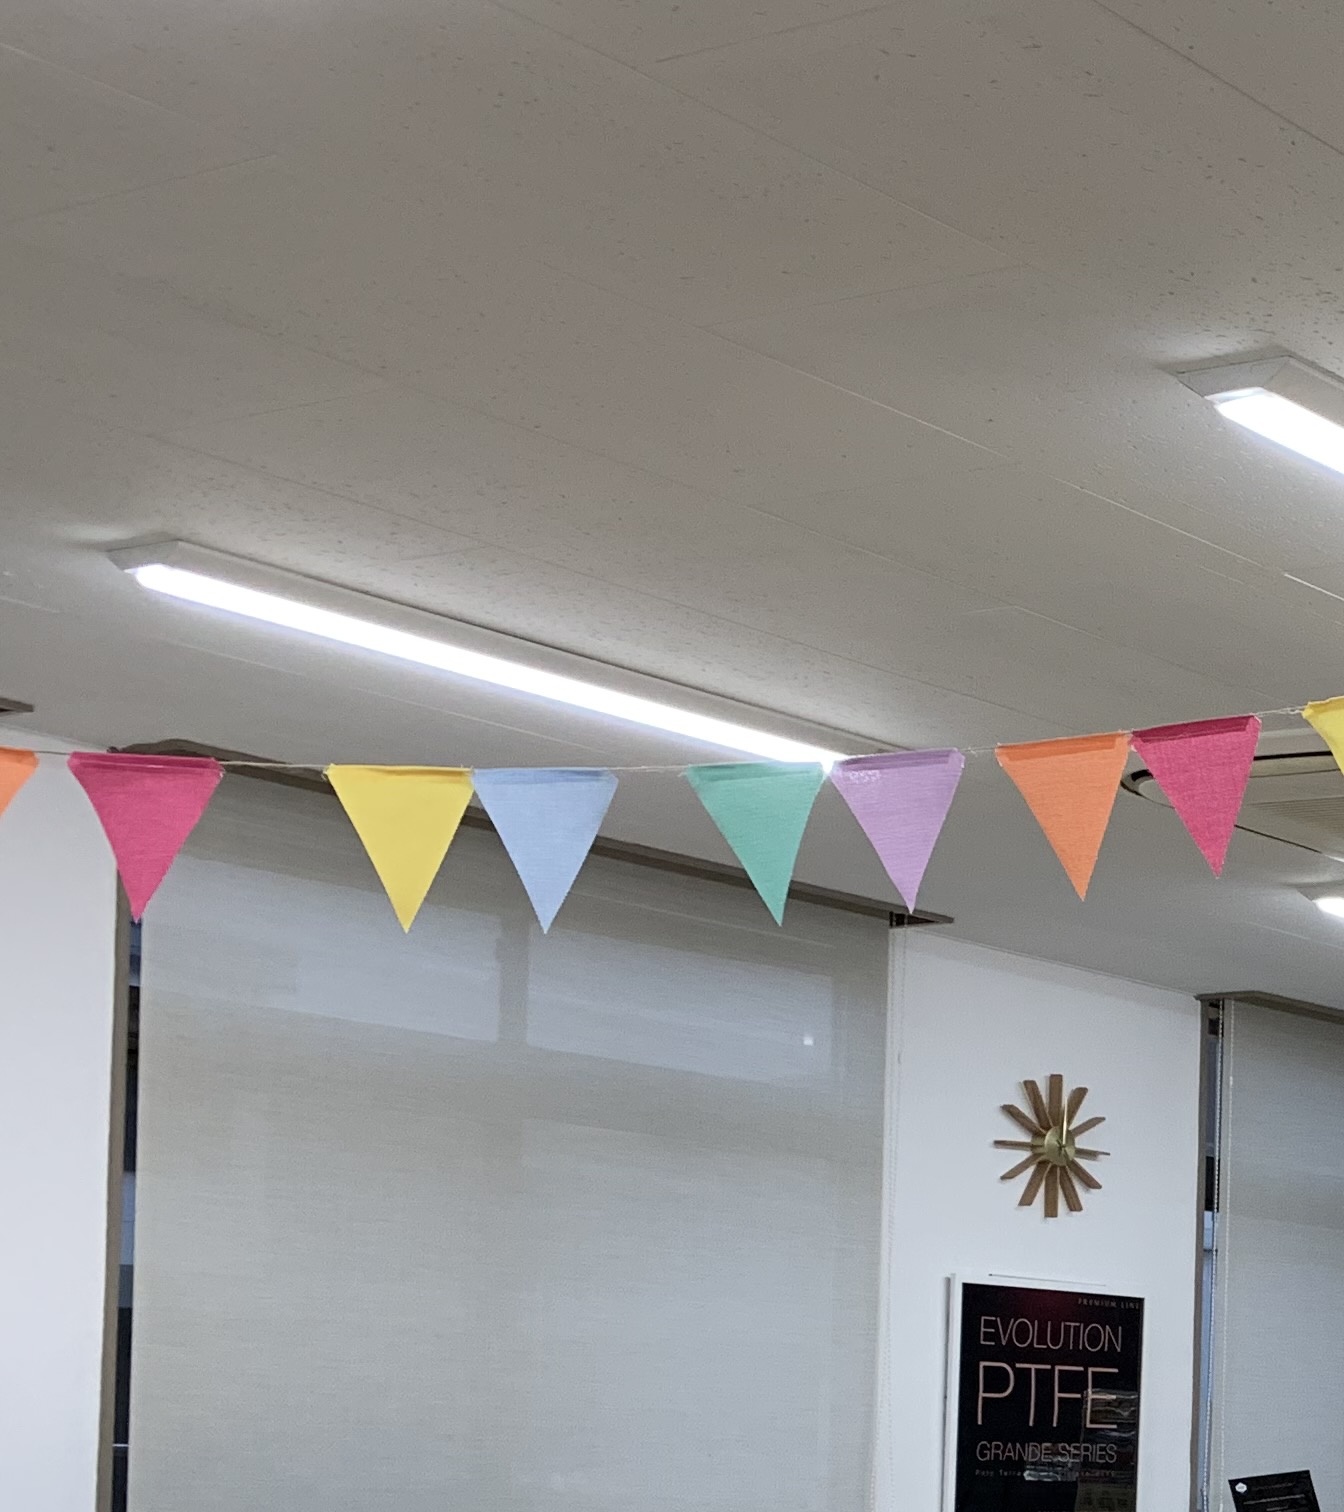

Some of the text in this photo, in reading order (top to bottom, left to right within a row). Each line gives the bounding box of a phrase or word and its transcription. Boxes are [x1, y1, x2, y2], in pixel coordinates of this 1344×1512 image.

[980, 1316, 1122, 1352] EVOLUTION
[977, 1361, 1119, 1429] PTFE
[976, 1441, 1118, 1464] GRANDE SERIES
